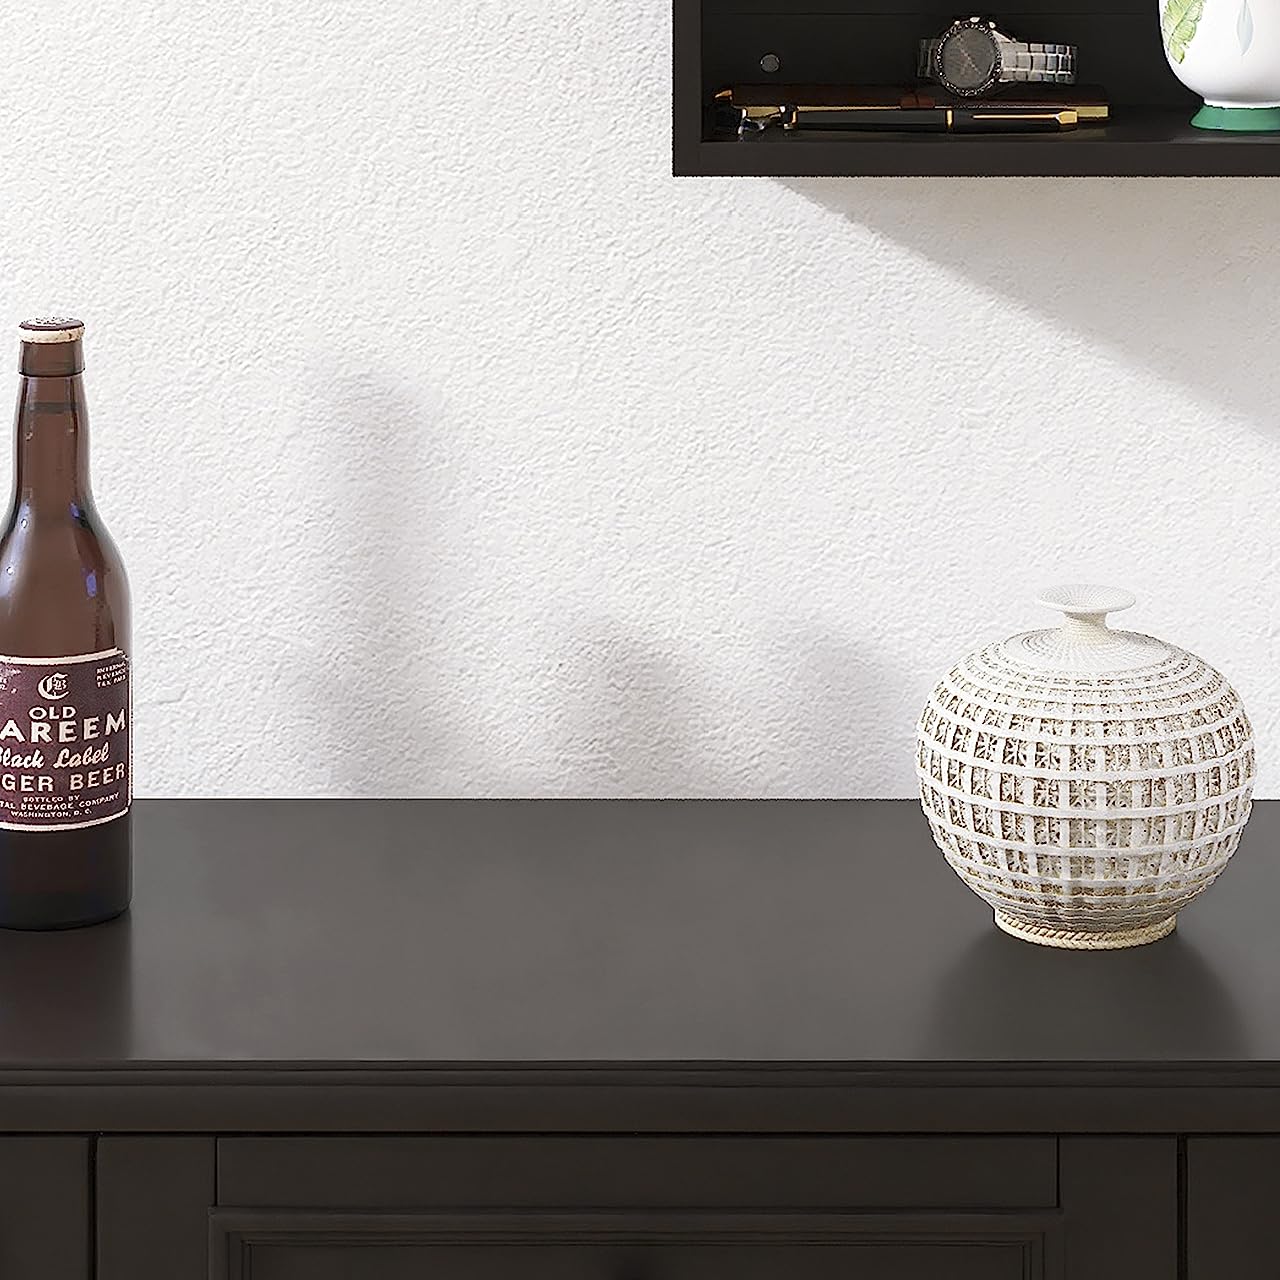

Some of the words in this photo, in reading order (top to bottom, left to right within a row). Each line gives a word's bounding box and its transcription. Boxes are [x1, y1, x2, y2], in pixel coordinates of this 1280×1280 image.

[0, 708, 127, 743] AREEM
[28, 706, 77, 720] OLD
[53, 741, 110, 769] Label
[1, 773, 54, 792] GER
[70, 762, 125, 791] BEER
[21, 803, 74, 811] BEVERAGE
[79, 792, 119, 808] COMPANY
